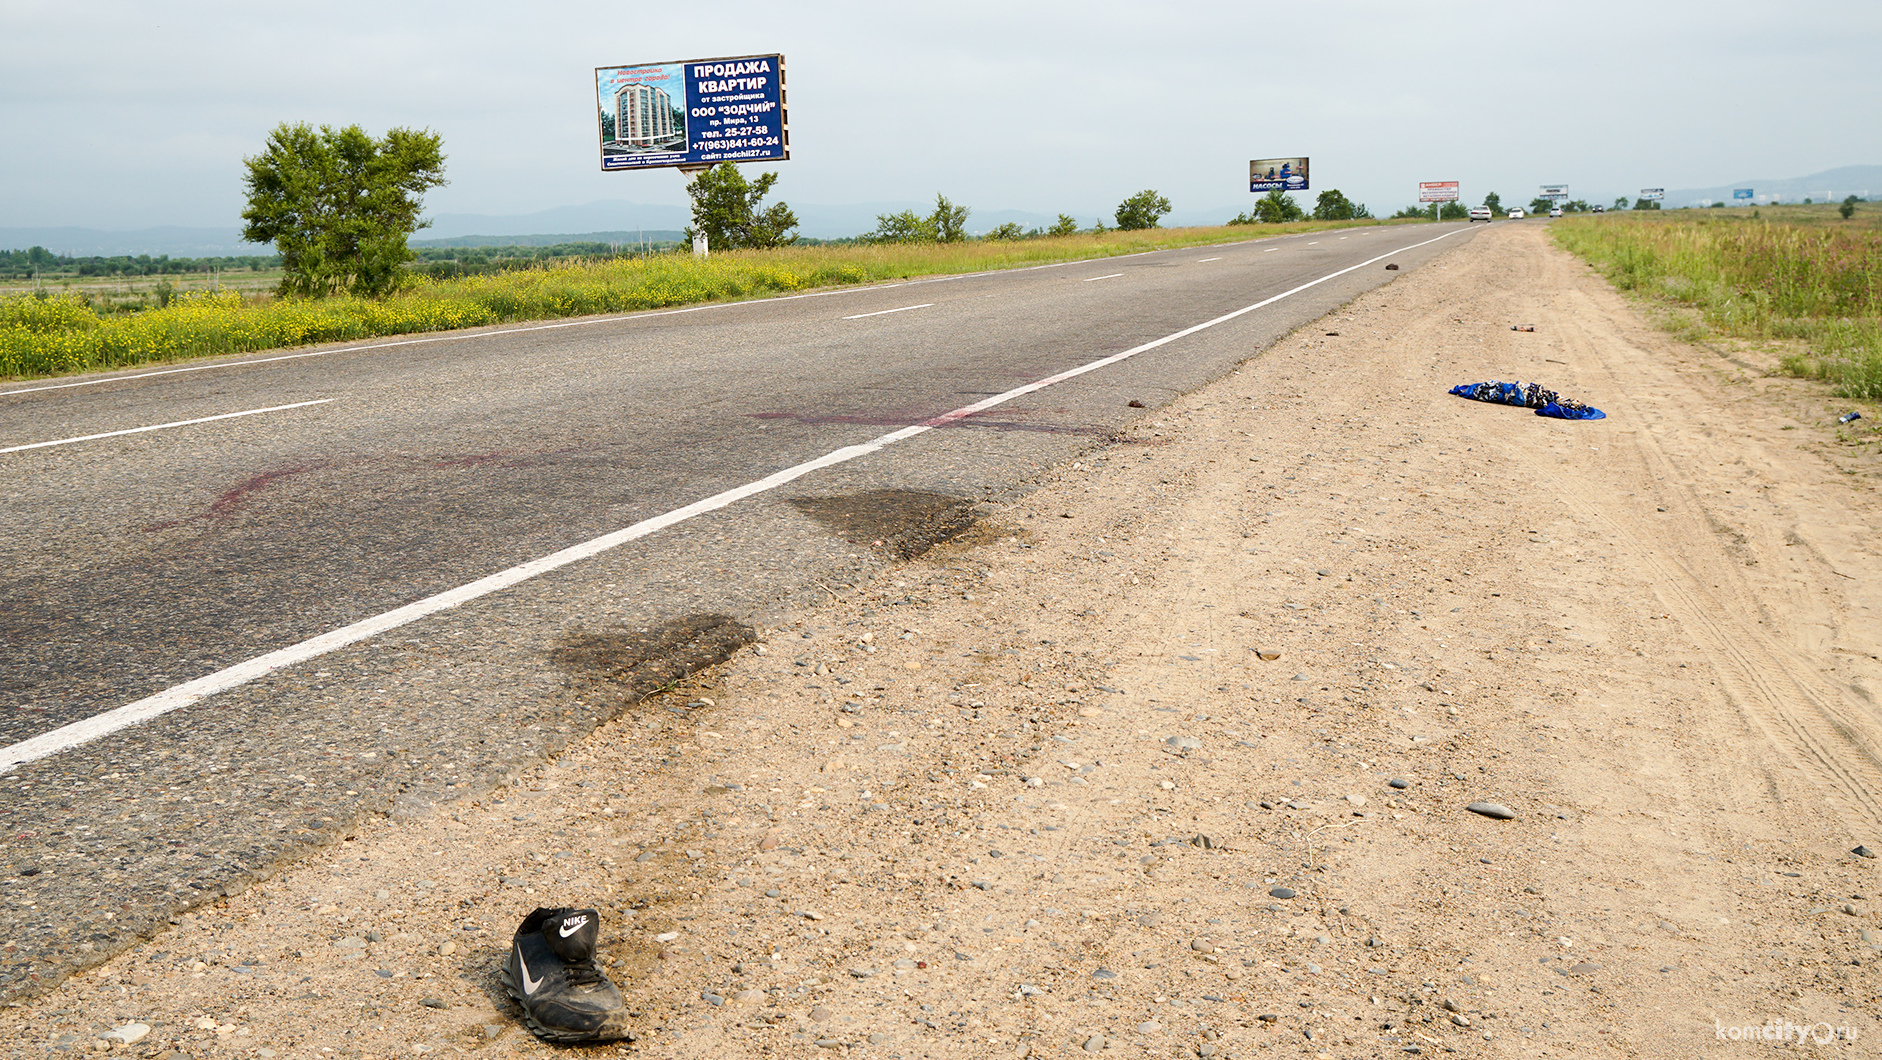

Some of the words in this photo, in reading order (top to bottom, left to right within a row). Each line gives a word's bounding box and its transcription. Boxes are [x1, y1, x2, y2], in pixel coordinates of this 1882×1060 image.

[694, 60, 770, 78] ПРОДАЖА
[699, 77, 766, 94] КВАРТИР
[712, 93, 764, 102] застройщика
[692, 106, 716, 117] ООО
[724, 117, 747, 125] Мира,
[725, 126, 768, 137] 25-27-58
[692, 136, 779, 151] +7(963)841-60-24
[724, 150, 770, 158] zodchii27.ru
[564, 915, 588, 926] NIKE
